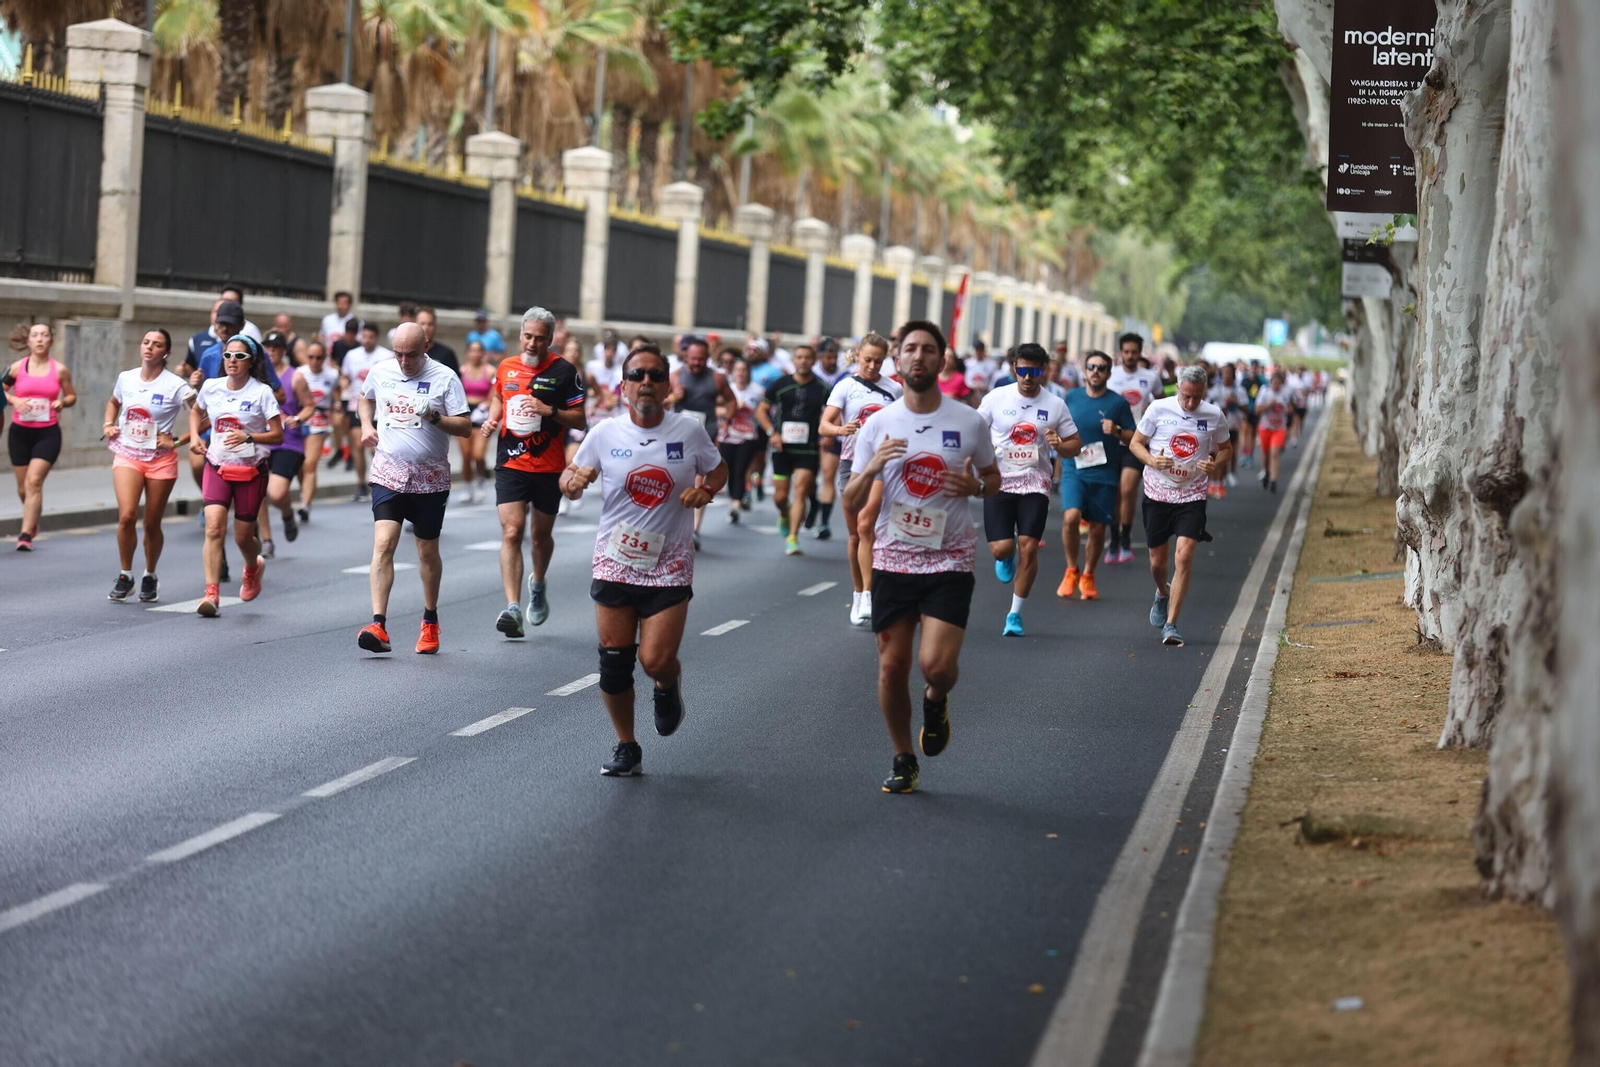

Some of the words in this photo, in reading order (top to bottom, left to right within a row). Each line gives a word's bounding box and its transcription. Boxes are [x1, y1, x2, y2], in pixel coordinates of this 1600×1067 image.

[1344, 26, 1435, 46] moderni
[1373, 46, 1434, 66] latent
[1350, 79, 1408, 88] VANGUARDISTAS
[1350, 163, 1379, 171] Fundación
[1350, 168, 1371, 177] Unicaja
[388, 405, 415, 414] 1326
[1008, 451, 1033, 459] 1007
[908, 472, 939, 487] FRENO
[1169, 467, 1188, 477] 608
[633, 475, 669, 491] PONLE
[631, 483, 665, 499] FRENO
[902, 511, 932, 528] 315
[621, 533, 649, 552] 734
